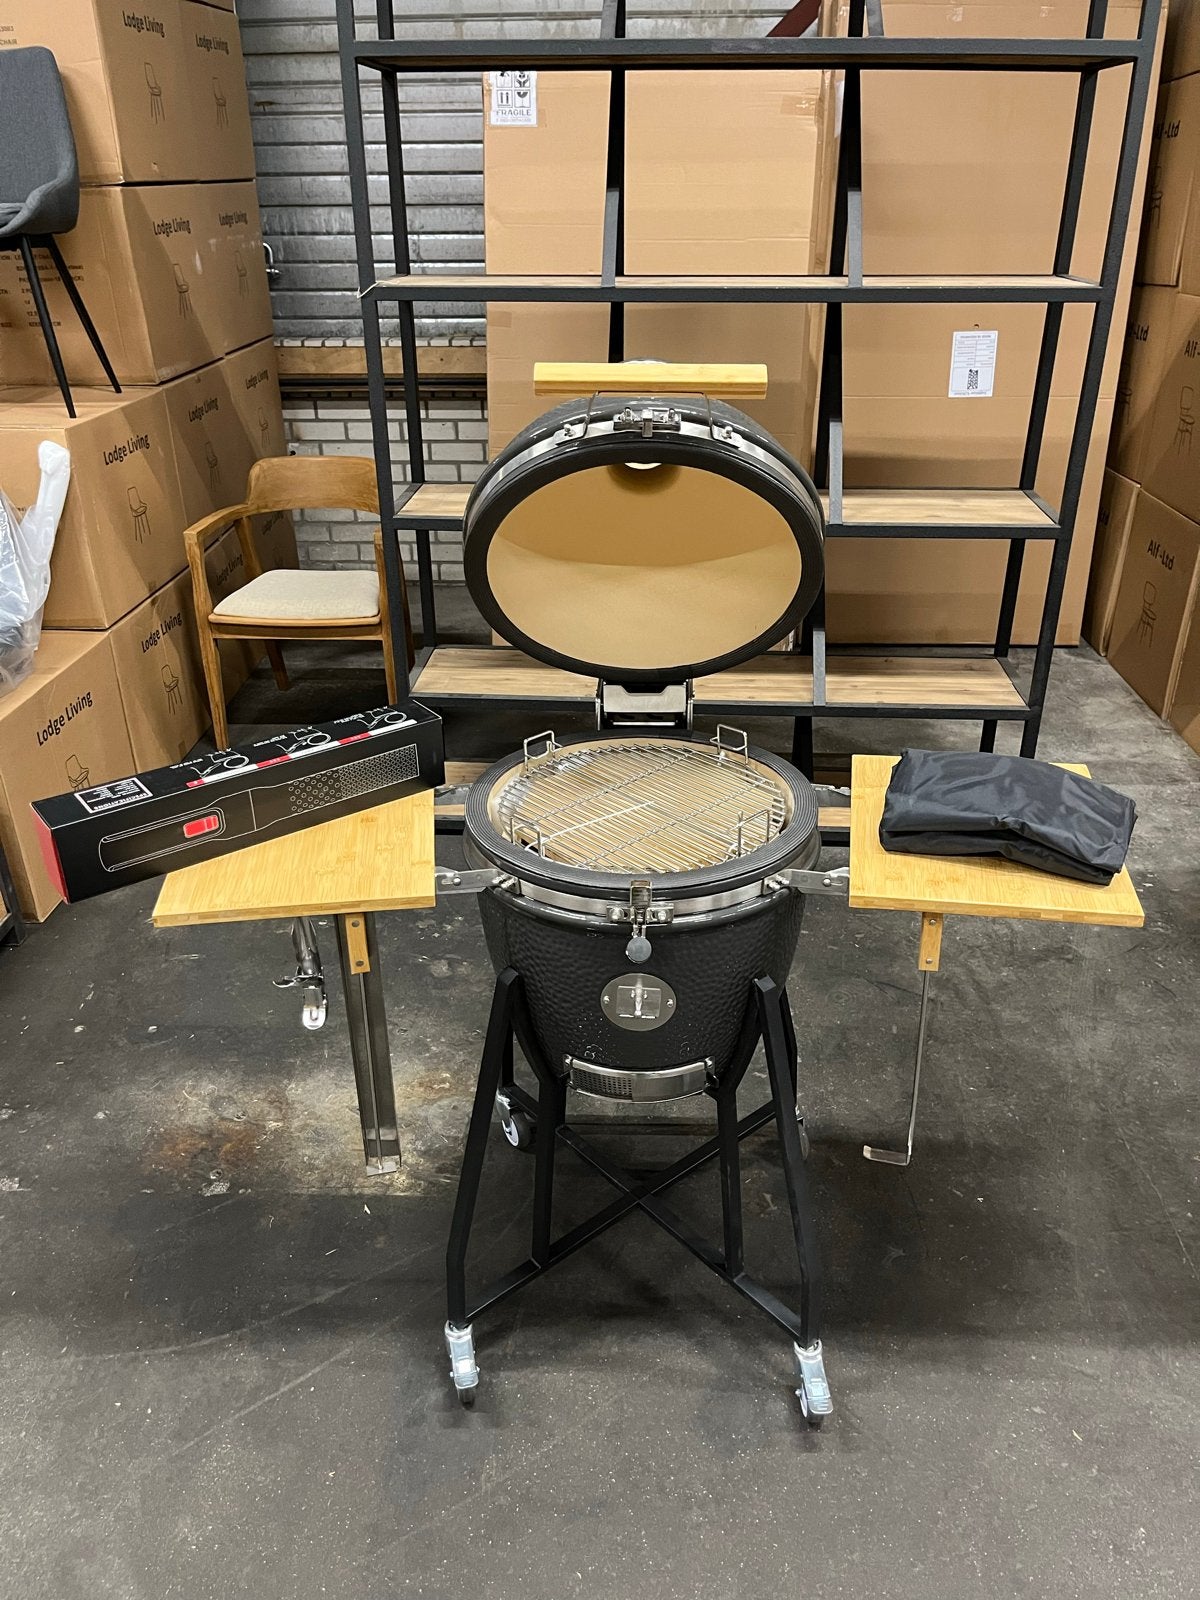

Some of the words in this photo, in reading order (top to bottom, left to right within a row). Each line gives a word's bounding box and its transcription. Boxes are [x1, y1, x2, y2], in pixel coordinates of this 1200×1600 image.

[122, 10, 145, 33] Lodge
[143, 15, 165, 38] Living
[195, 33, 213, 52] Lodge
[212, 37, 229, 55] Living
[152, 219, 173, 237] Lodge
[172, 217, 191, 234] Living
[188, 403, 205, 422] Lodge
[203, 397, 218, 413] Living
[103, 444, 128, 466] Lodge
[127, 434, 150, 454] Living
[1147, 539, 1175, 570] Alf-Ltd
[141, 630, 161, 653] Lodge
[160, 612, 182, 636] Living
[36, 715, 66, 747] Lodge
[65, 691, 93, 722] Living
